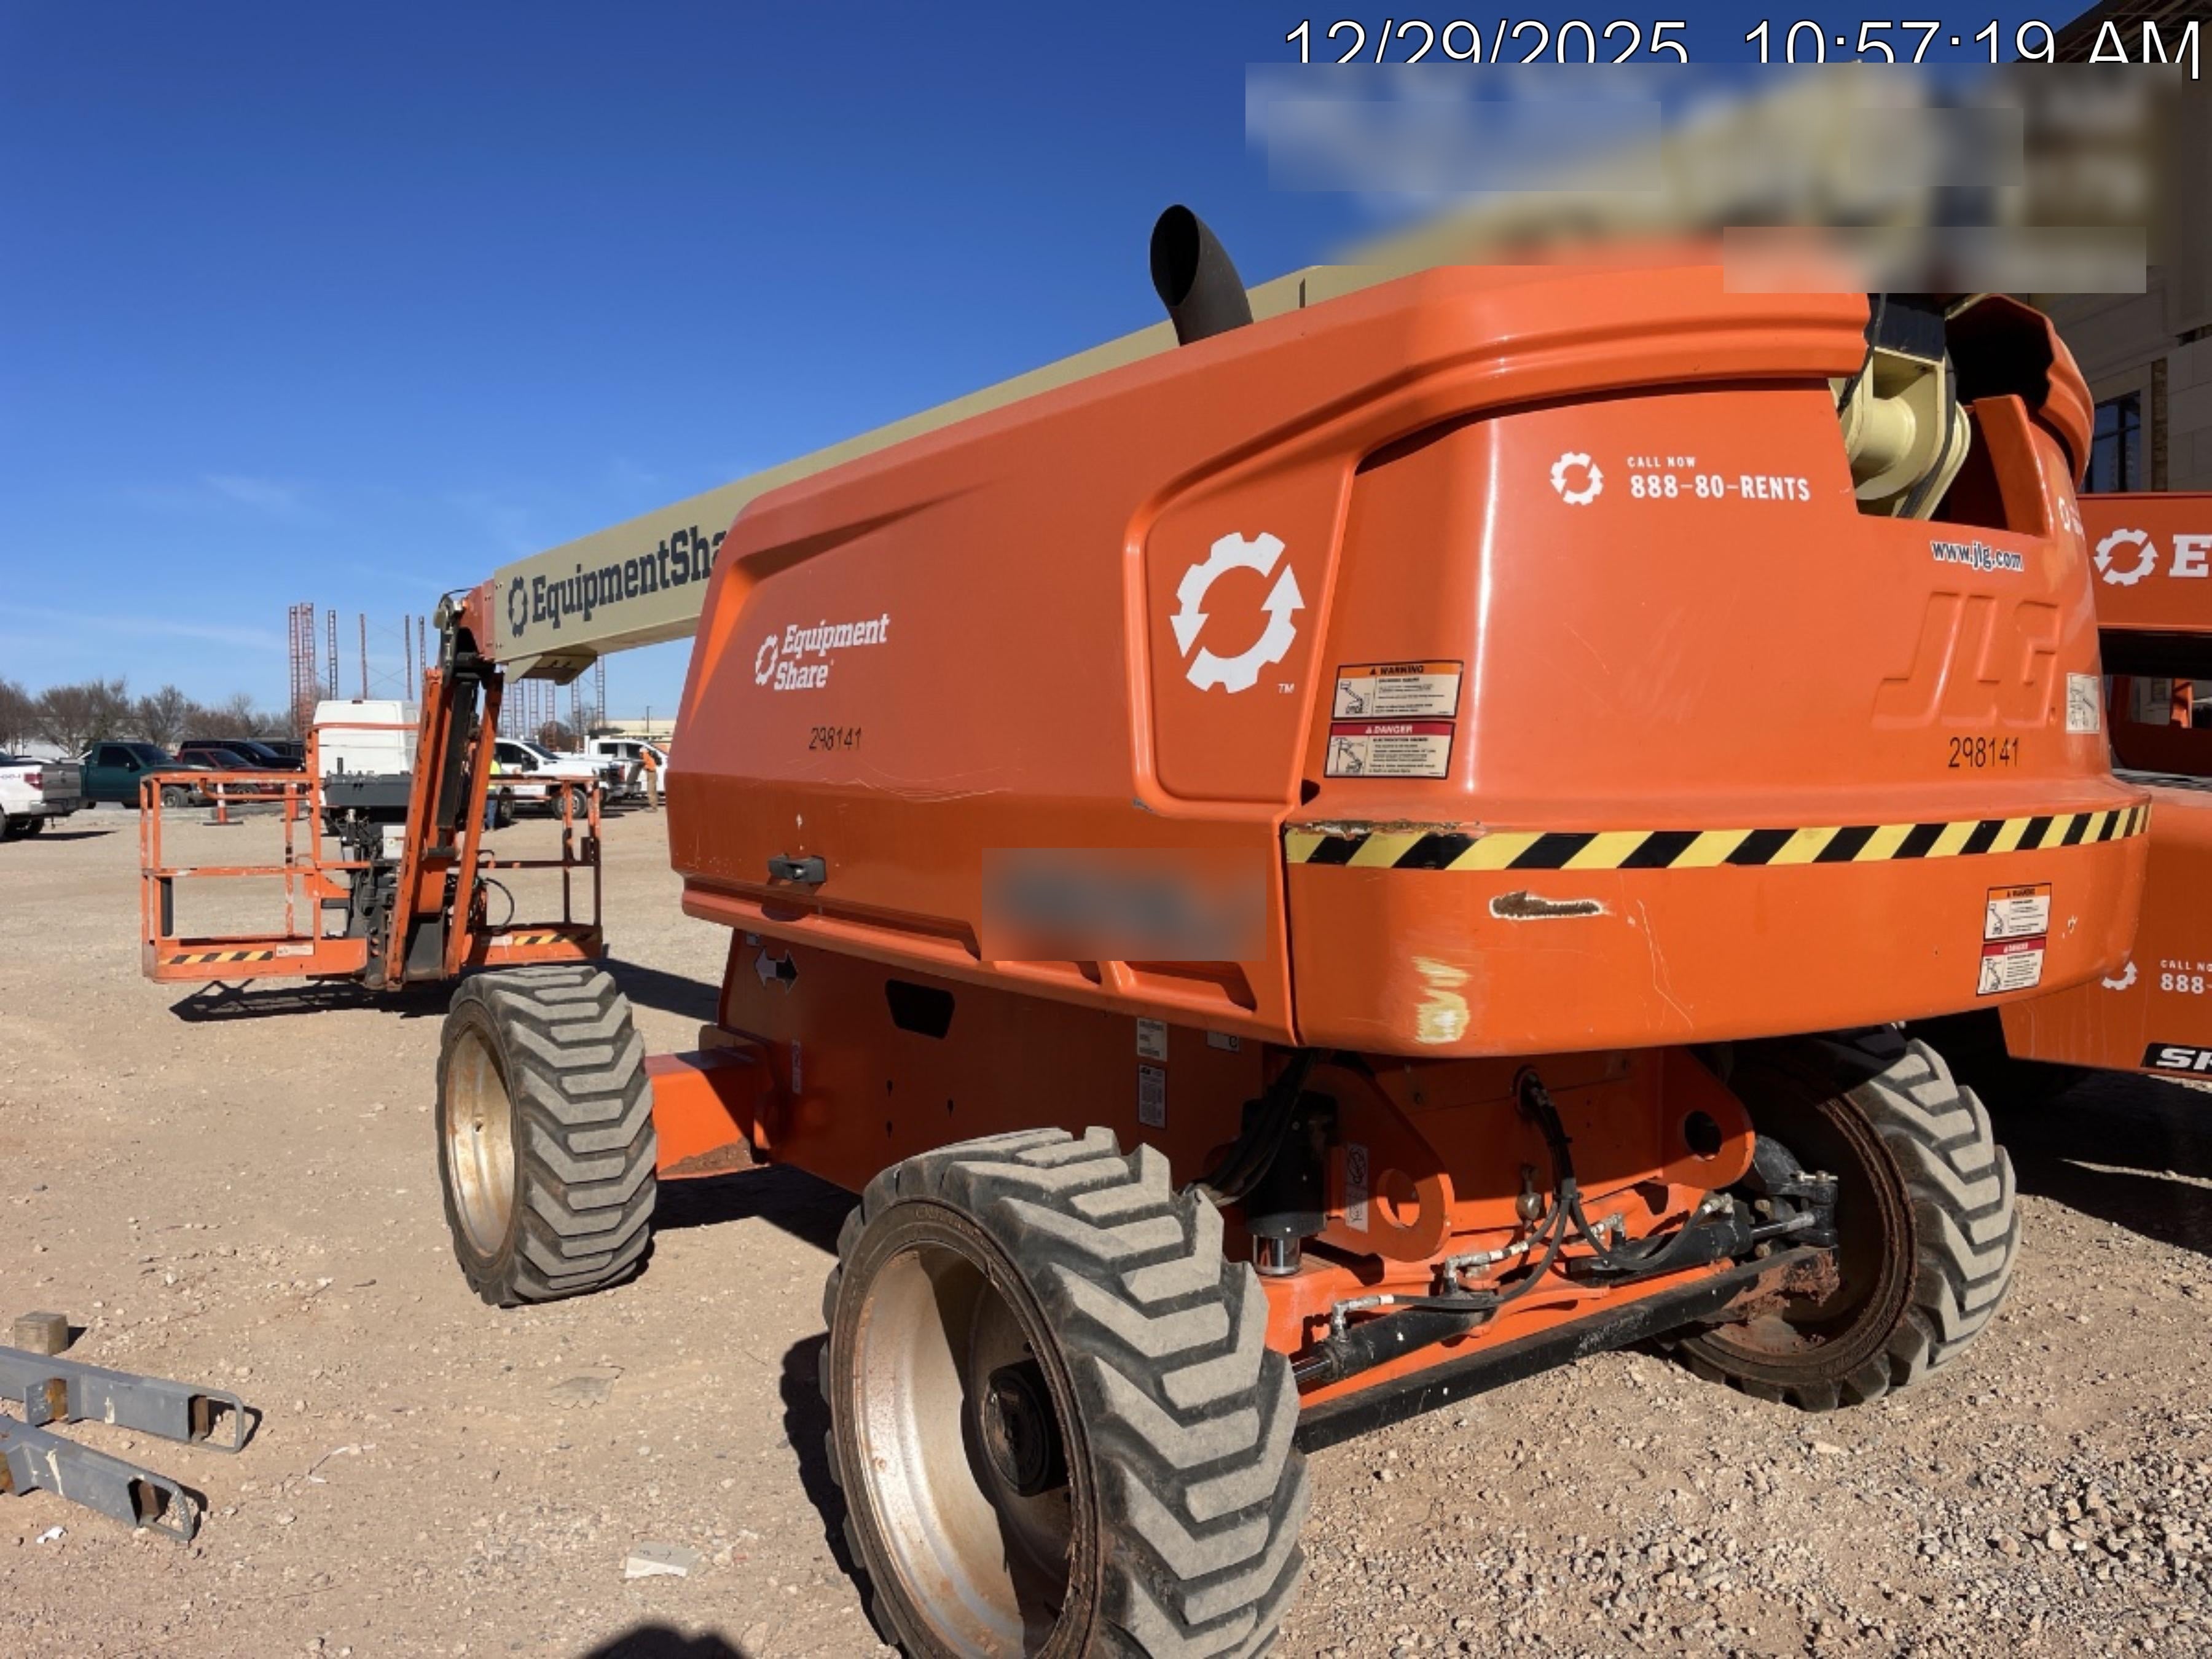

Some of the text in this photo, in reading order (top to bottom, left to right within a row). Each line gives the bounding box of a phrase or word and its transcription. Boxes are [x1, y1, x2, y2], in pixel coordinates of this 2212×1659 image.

[1627, 457, 1696, 468] CALL NOW
[1630, 474, 1810, 501] 888-80-RENTS
[1931, 541, 2024, 571] www.jlg.com
[782, 613, 890, 659] Equipment
[1871, 590, 2061, 730] JLG
[774, 661, 828, 691] Share
[1279, 683, 1294, 694] TM
[809, 726, 861, 751] 298141
[1373, 724, 1413, 734] DANGER
[1948, 737, 2019, 768] 298141
[2160, 959, 2192, 970] CALL
